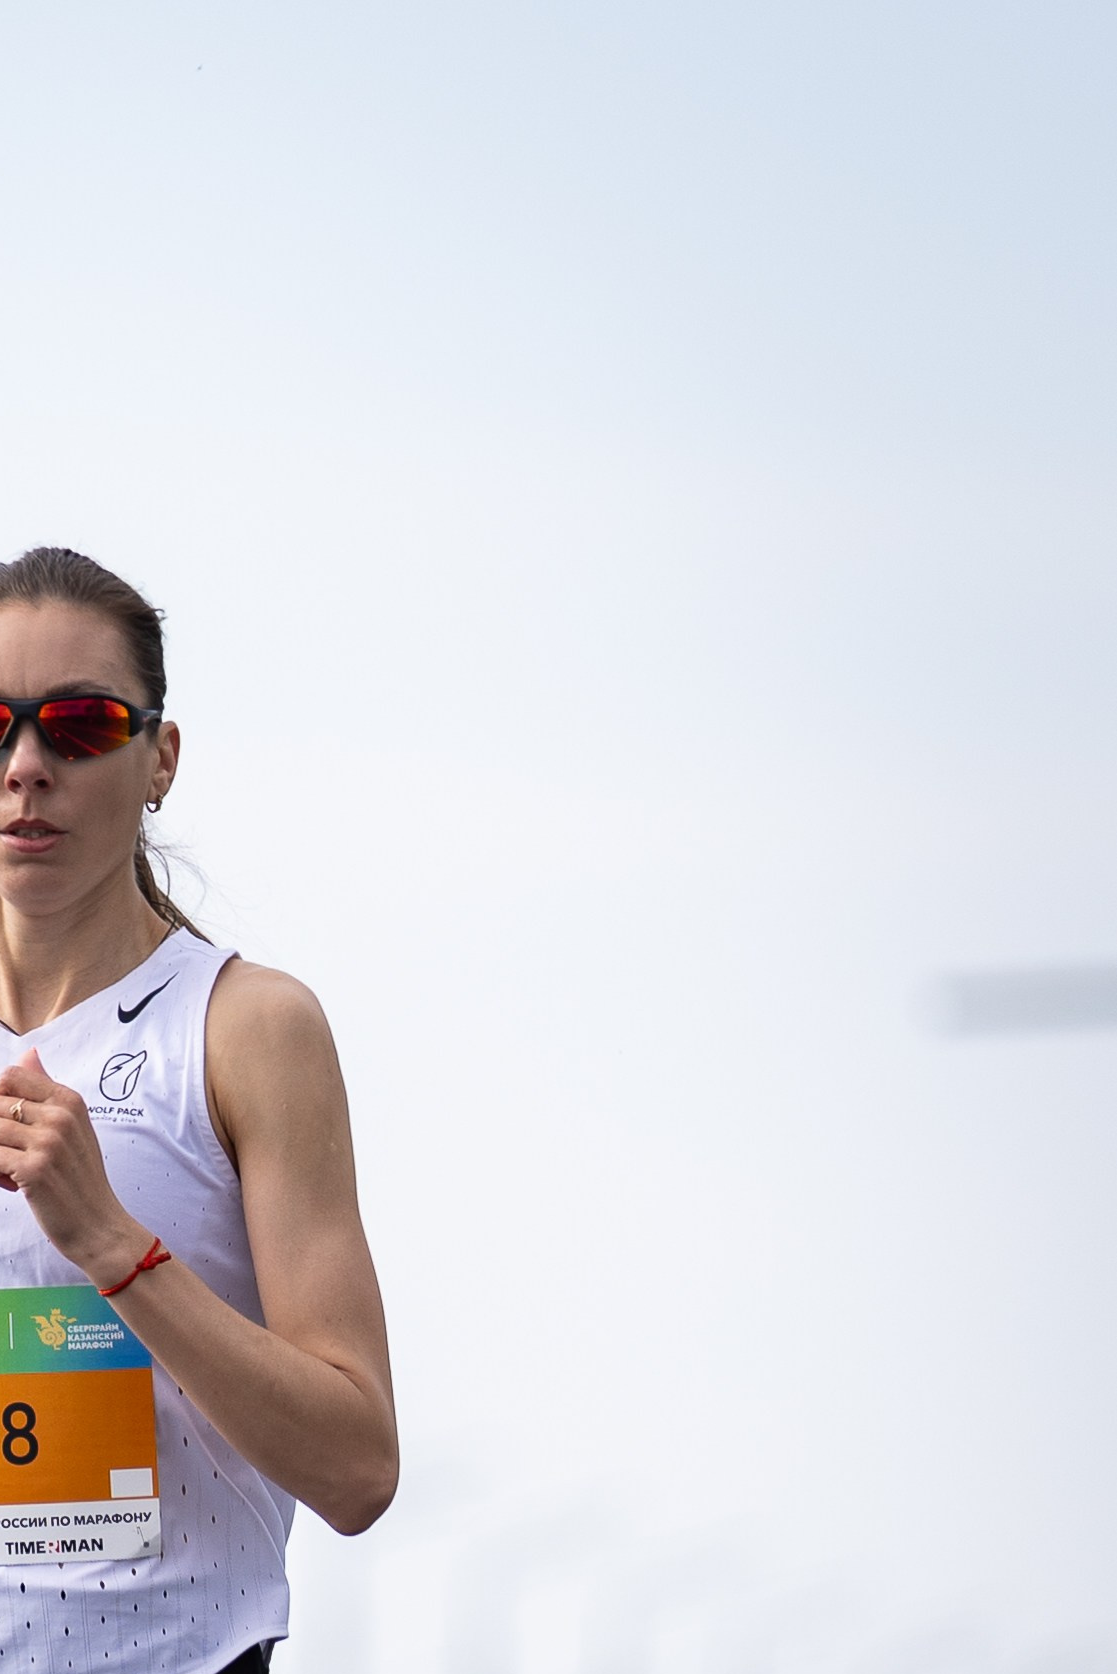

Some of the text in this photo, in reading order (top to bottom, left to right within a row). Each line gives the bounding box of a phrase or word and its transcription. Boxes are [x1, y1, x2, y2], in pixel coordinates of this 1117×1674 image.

[117, 1107, 144, 1117] PACK
[67, 1322, 119, 1333] СБЕРПРАЙМ
[67, 1331, 125, 1342] КАЗАНСКИЙ
[68, 1341, 113, 1350] МАРАФОН
[50, 1516, 71, 1527] ПО
[73, 1512, 152, 1526] МАРАФОНУ
